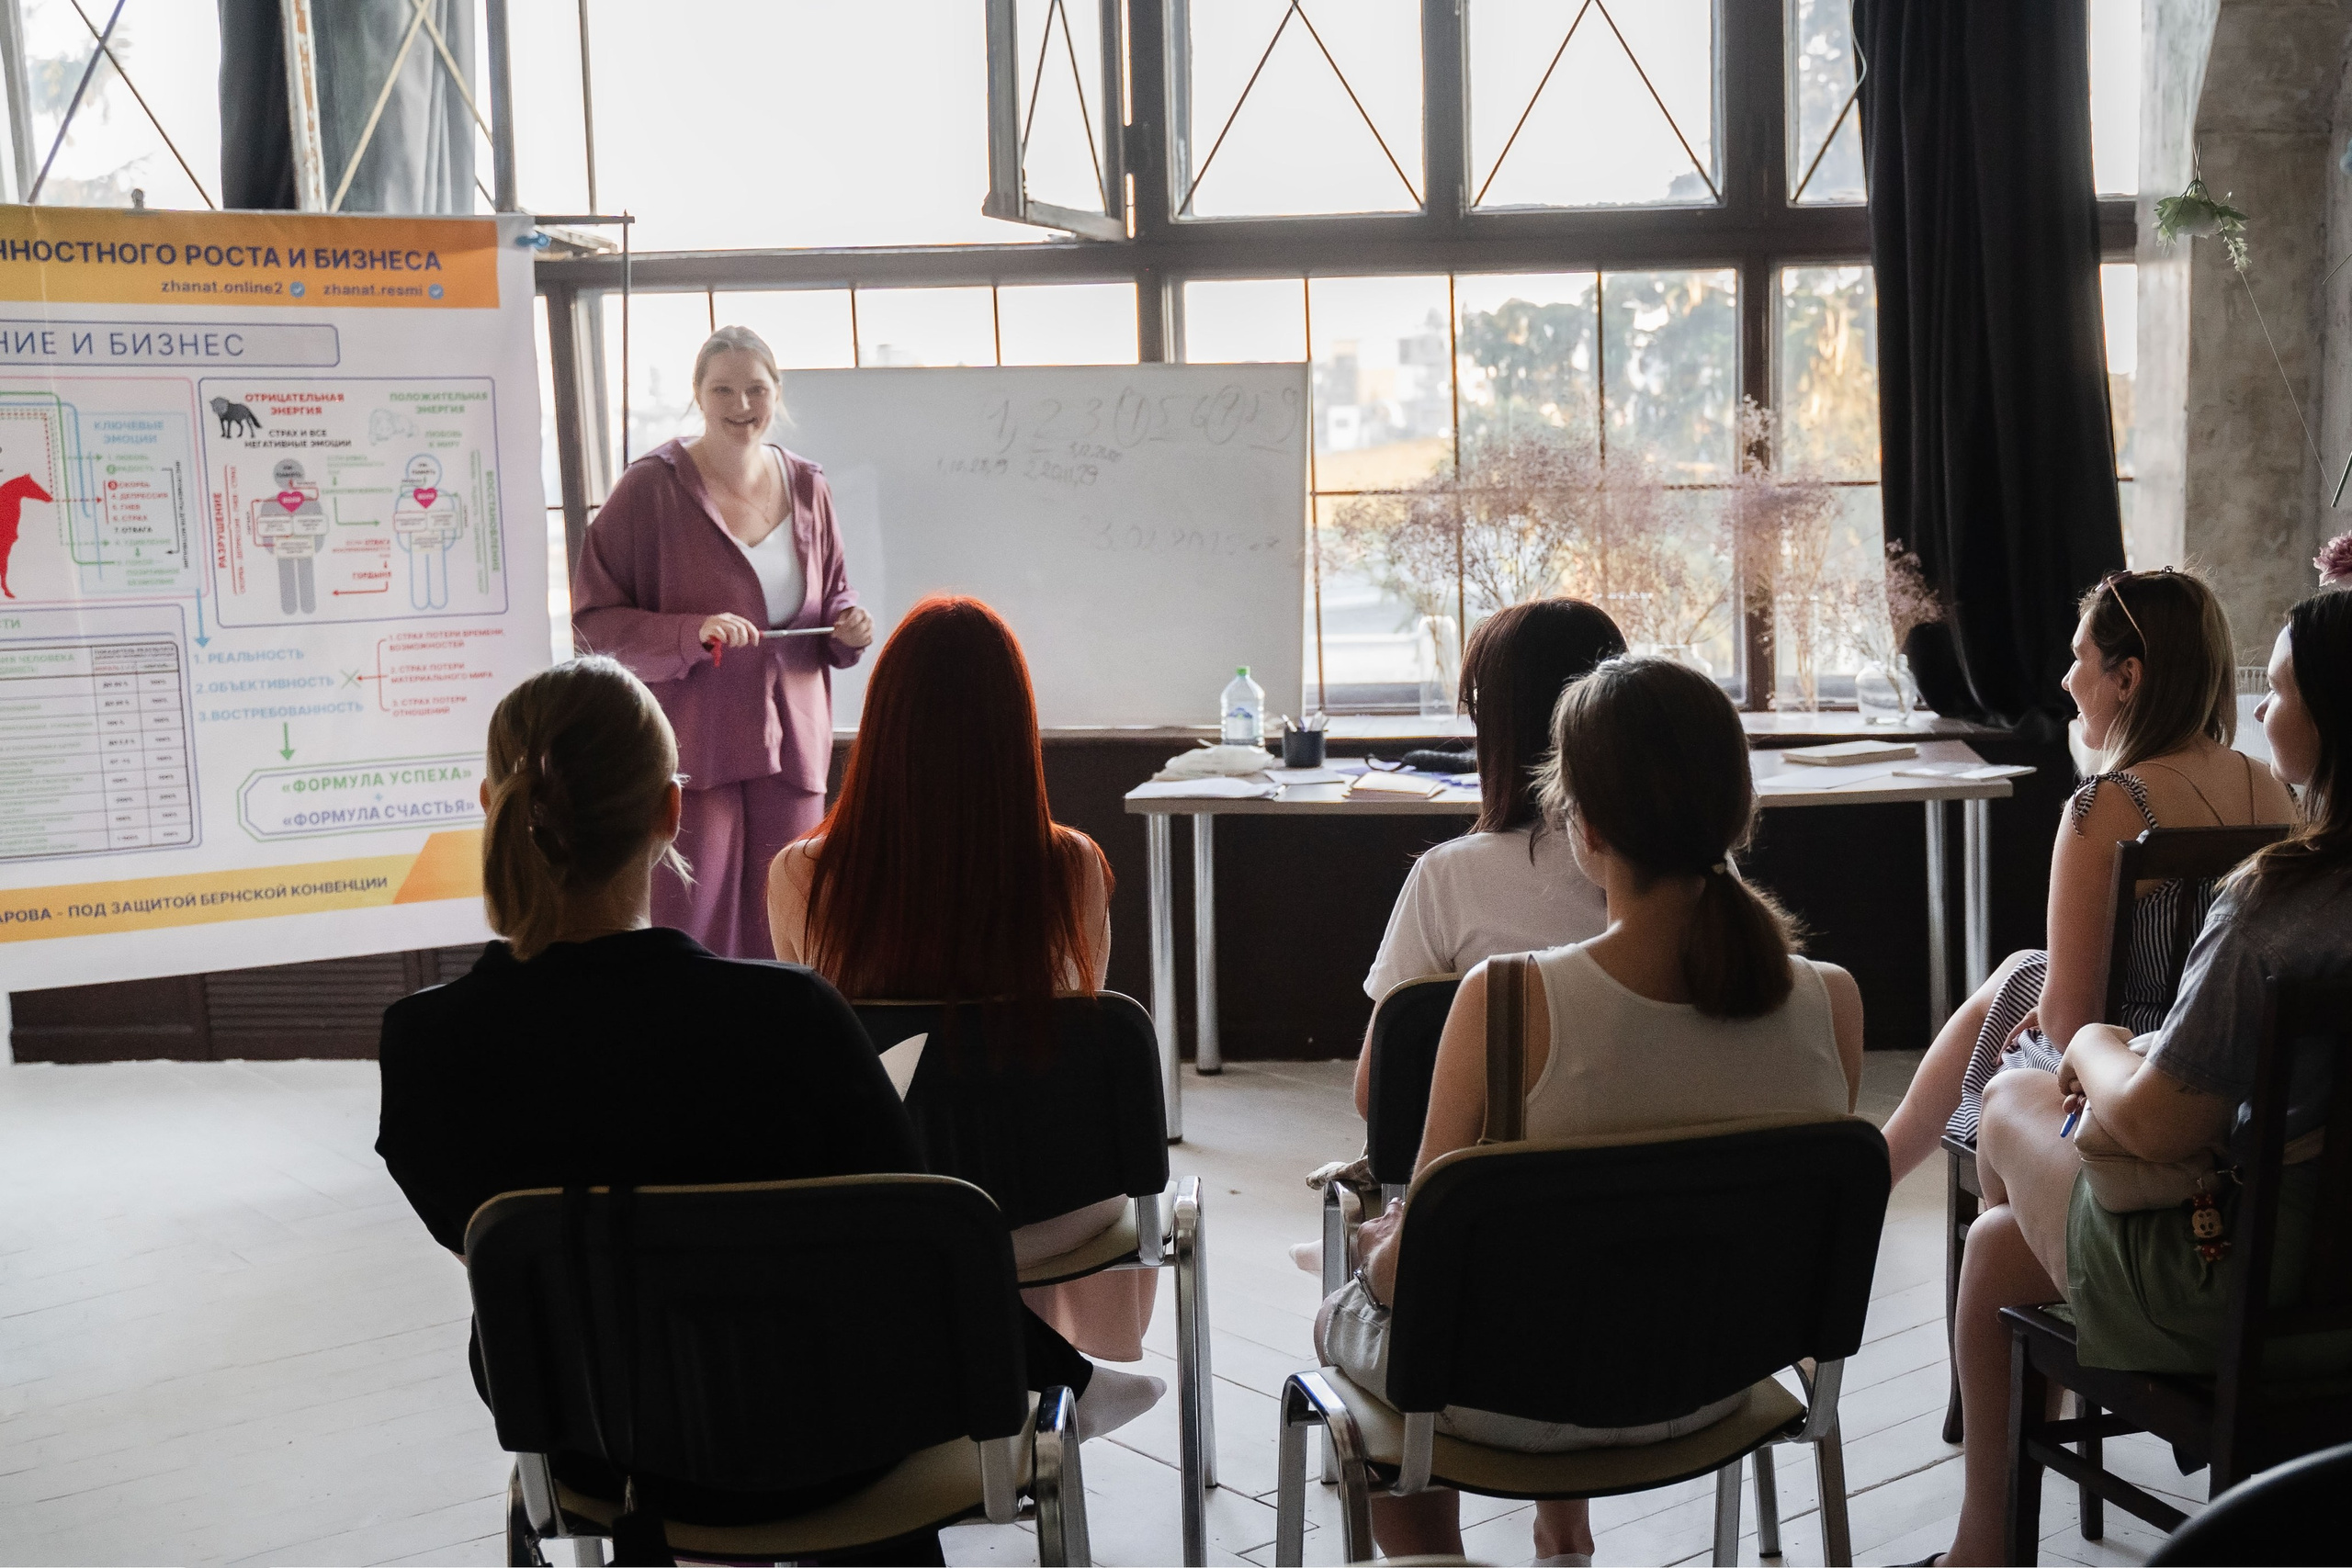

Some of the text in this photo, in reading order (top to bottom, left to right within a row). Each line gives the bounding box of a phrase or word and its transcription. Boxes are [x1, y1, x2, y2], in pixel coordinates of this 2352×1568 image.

[185, 243, 281, 268] РОСТА
[288, 247, 306, 268] И
[314, 248, 442, 271] БИЗНЕСА
[161, 280, 423, 297] zhanat.online2 zhanat.resmi
[73, 331, 93, 355] И
[109, 332, 244, 356] БИЗНЕС
[244, 392, 345, 403] ОТРИЦАТЕЛЬНАЯ
[390, 392, 489, 401] ПОЛОЖИТЕЛЬНАЯ
[270, 406, 323, 416] ЭНЕРГИЯ
[0, 618, 21, 629] ТИ
[208, 648, 305, 664] РЕАЛЬНОСТЬ
[281, 766, 471, 793] «ФОРМУЛА УСПЕХА»
[282, 799, 475, 826] «ФОРМУЛА СЧАСТЬЯ»
[68, 903, 107, 919] ПОД
[111, 892, 197, 915] ЗАЩИТОЙ
[200, 884, 287, 907] БЕРНСКОЙ
[290, 876, 388, 897] КОНВЕНЦИИ
